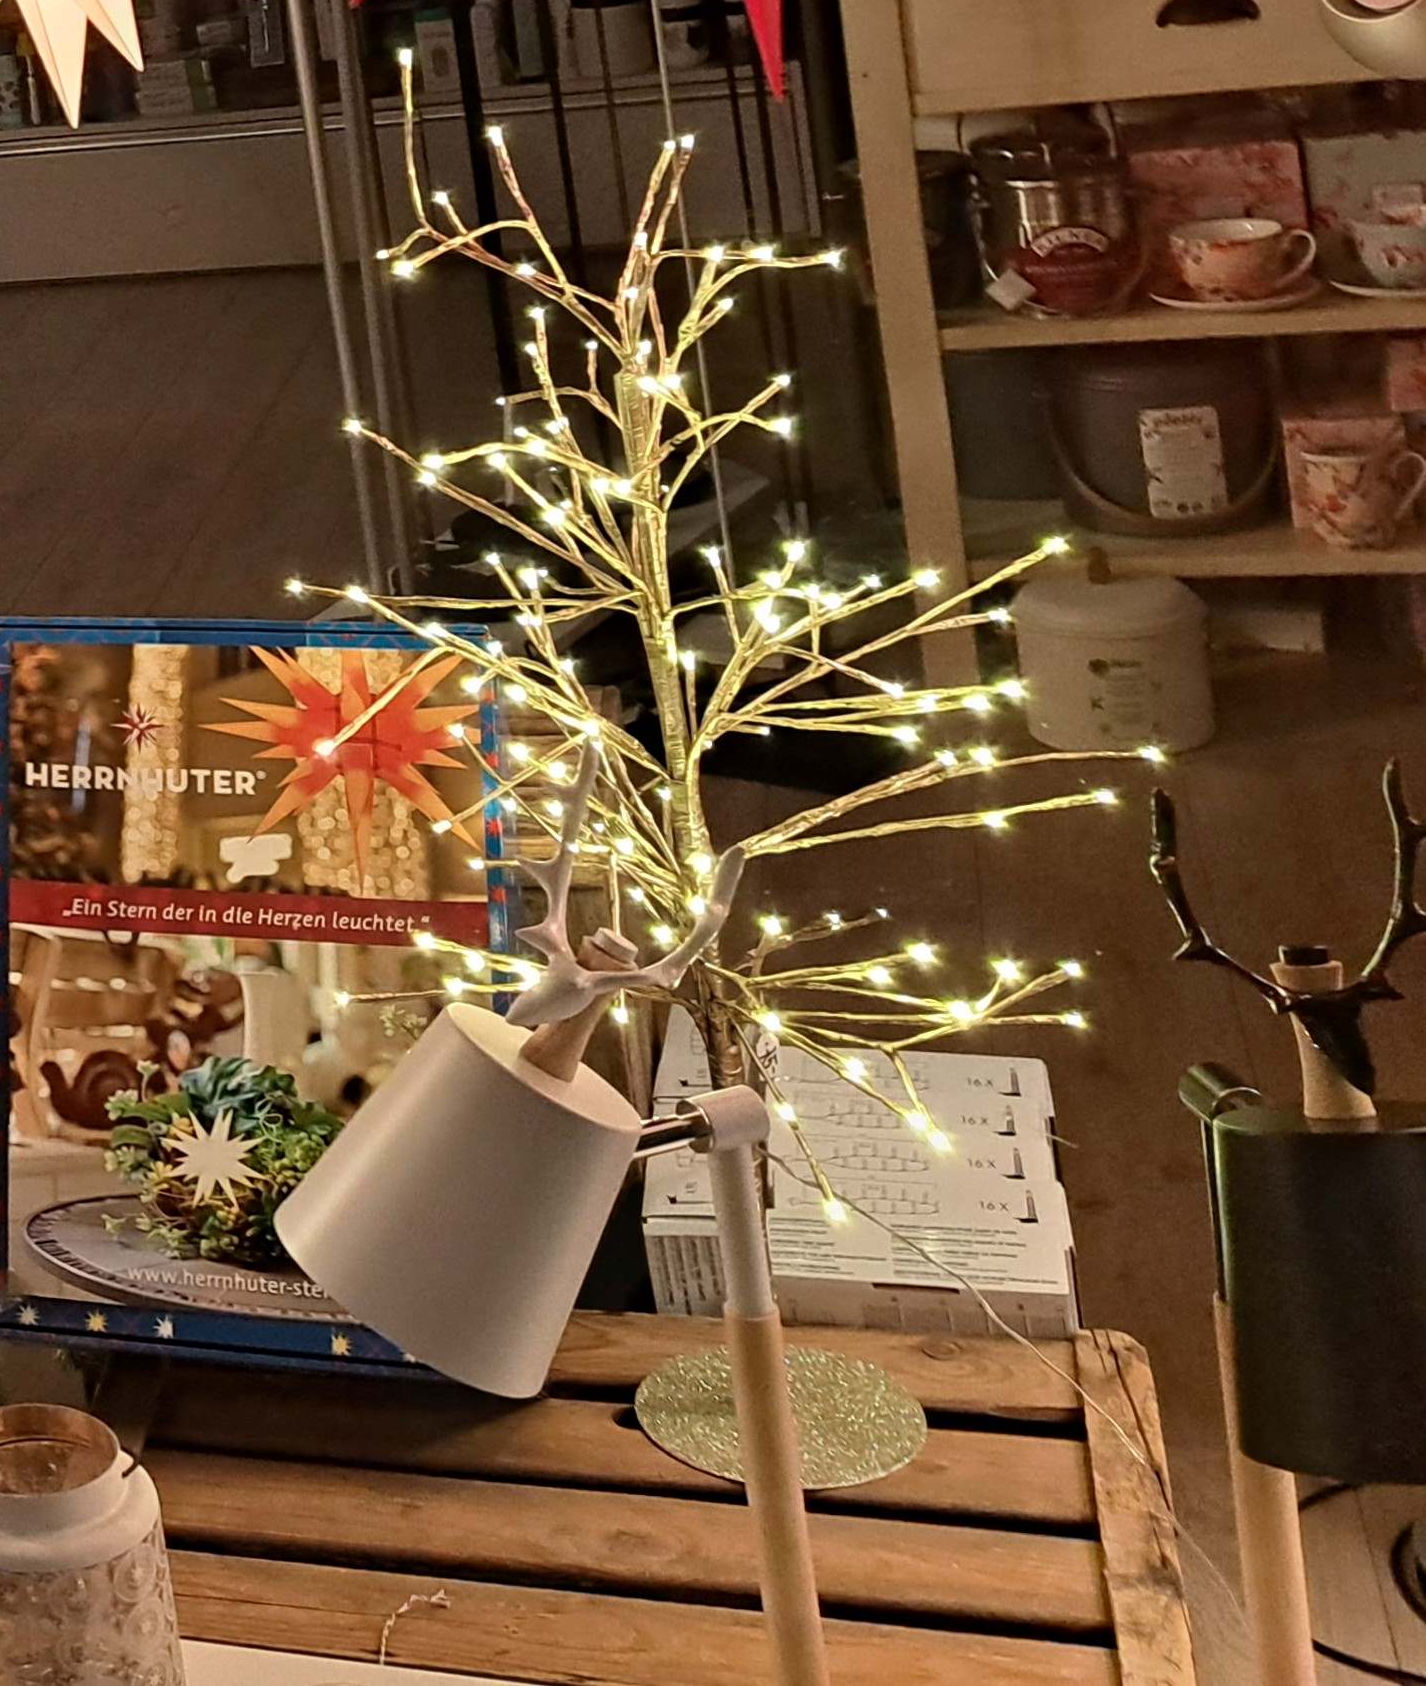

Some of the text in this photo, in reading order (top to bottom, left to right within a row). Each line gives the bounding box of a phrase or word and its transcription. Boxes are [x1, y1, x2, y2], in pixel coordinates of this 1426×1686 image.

[107, 899, 157, 920] Stern
[162, 903, 193, 922] der
[199, 905, 217, 923] in
[222, 906, 253, 925] die
[257, 907, 326, 931] Herzen
